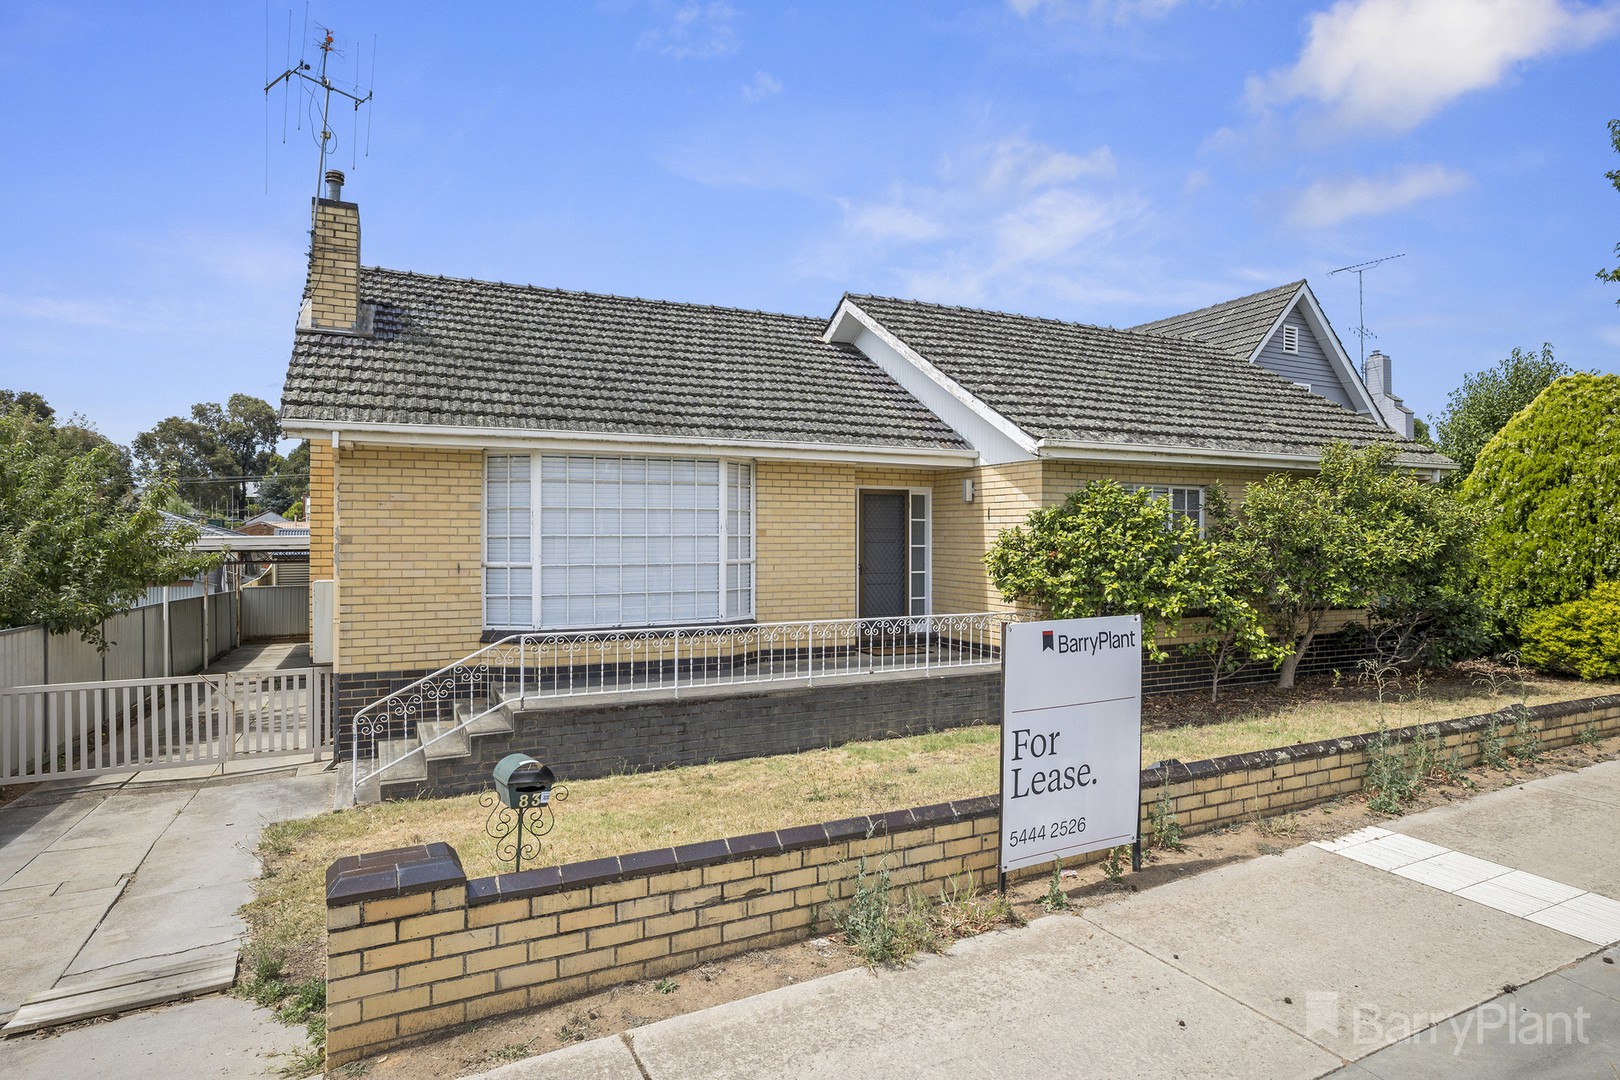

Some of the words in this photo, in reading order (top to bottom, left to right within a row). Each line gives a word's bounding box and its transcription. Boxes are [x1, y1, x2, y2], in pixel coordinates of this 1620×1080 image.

[1058, 630, 1136, 656] BarryPlant
[1011, 728, 1061, 762] For
[1011, 763, 1098, 799] Lease.
[519, 793, 541, 807] 83
[1009, 824, 1046, 848] 5444
[1050, 816, 1087, 840] 2526
